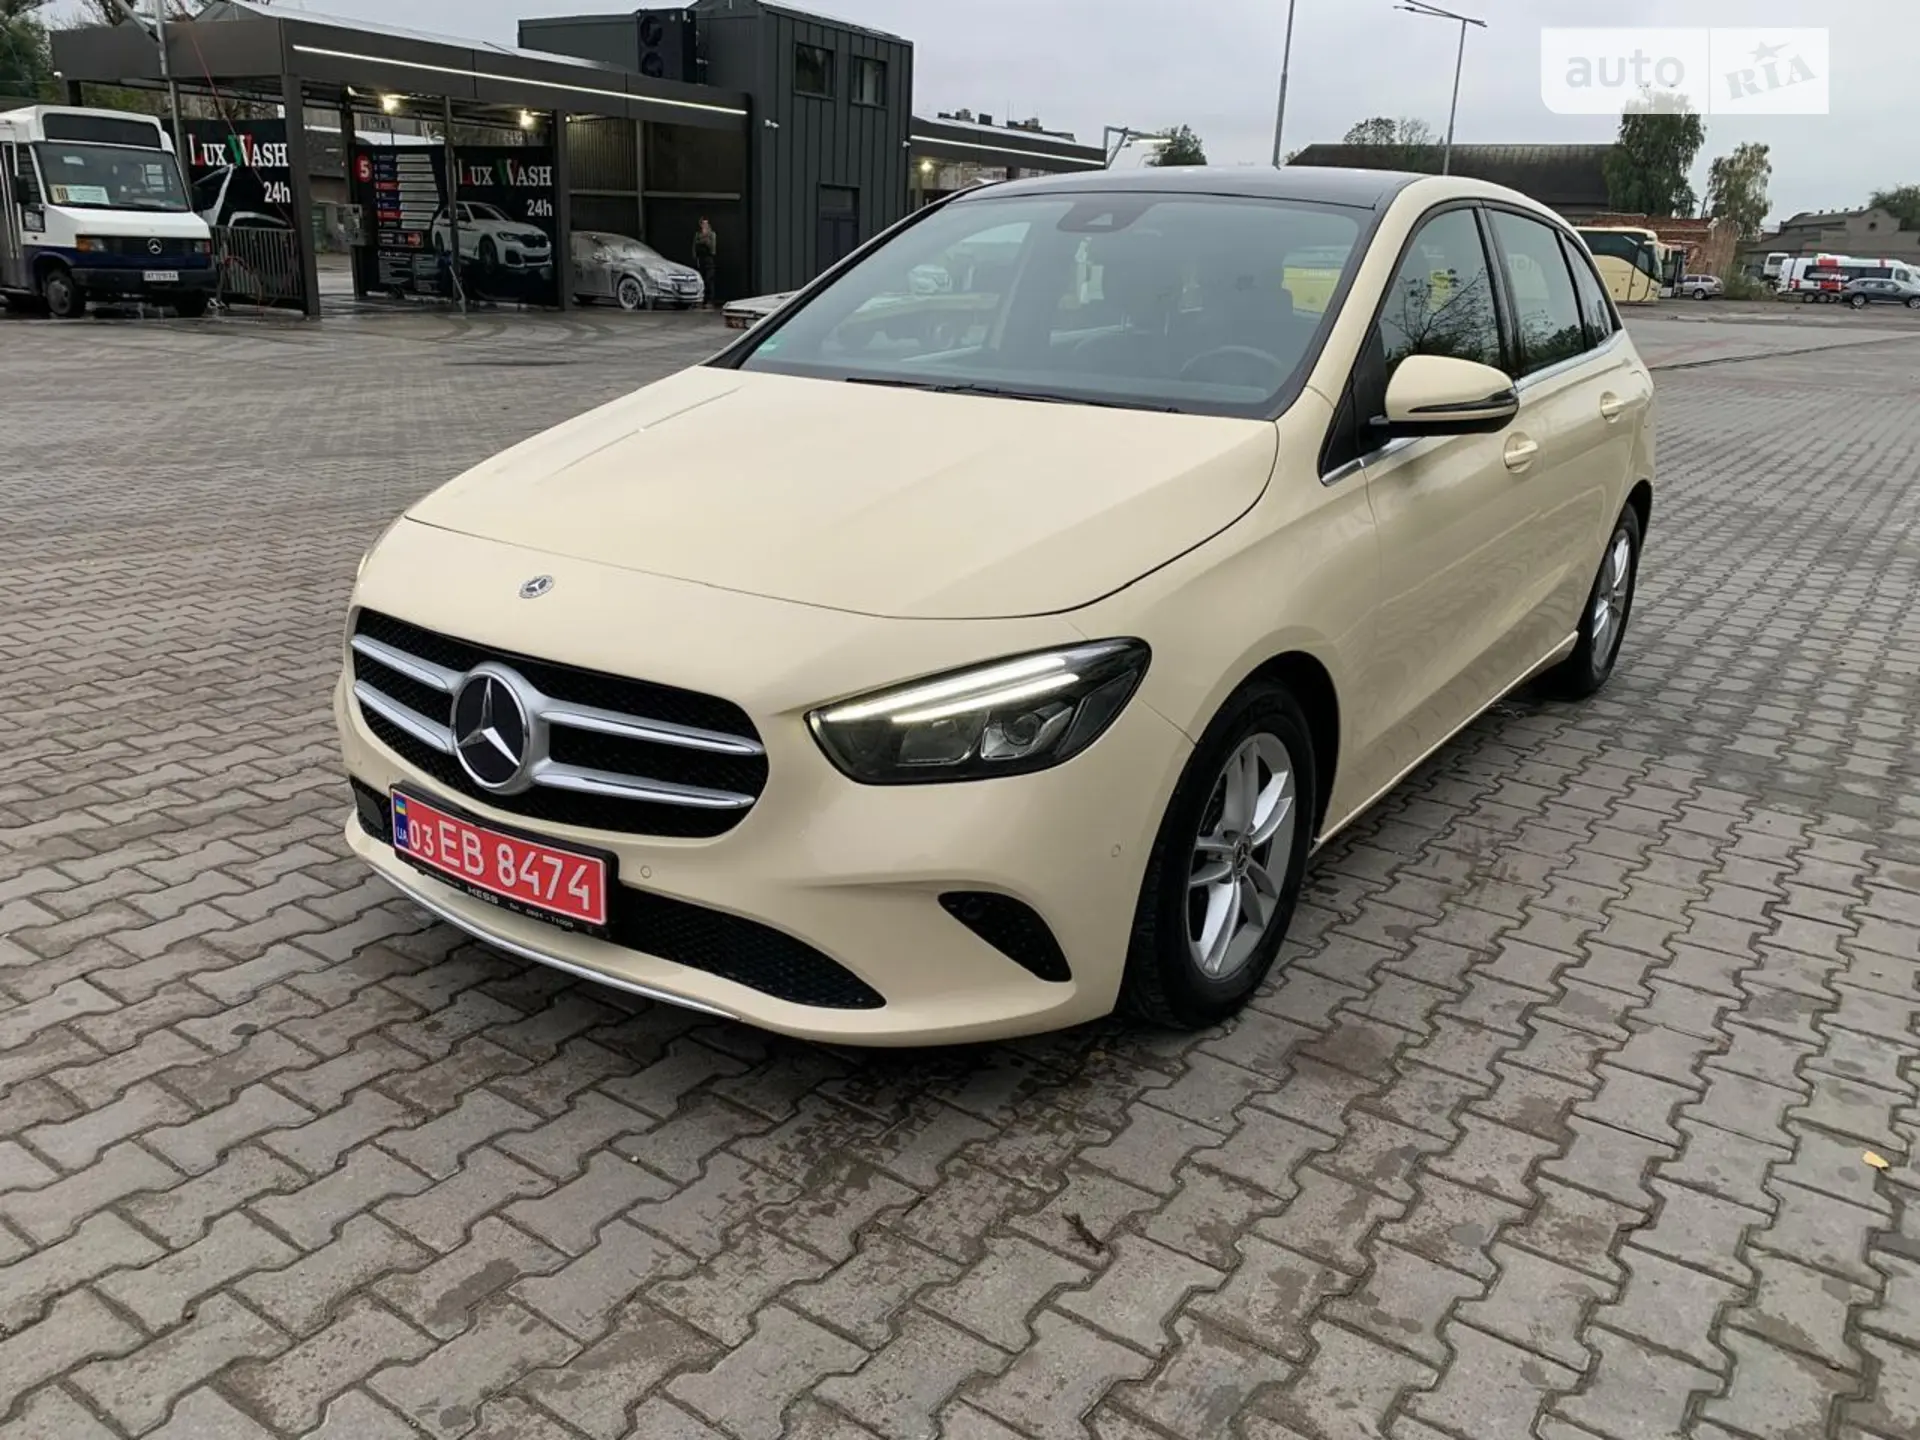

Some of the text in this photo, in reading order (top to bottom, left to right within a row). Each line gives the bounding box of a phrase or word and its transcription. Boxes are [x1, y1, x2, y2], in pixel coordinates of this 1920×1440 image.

[227, 134, 289, 167] WASH
[359, 159, 371, 179] 5
[496, 158, 553, 186] WASH
[263, 181, 291, 204] 24h
[526, 198, 553, 217] 24h
[396, 825, 409, 843] UA
[409, 819, 434, 857] 03
[438, 819, 485, 876] EB
[496, 842, 590, 911] 8474
